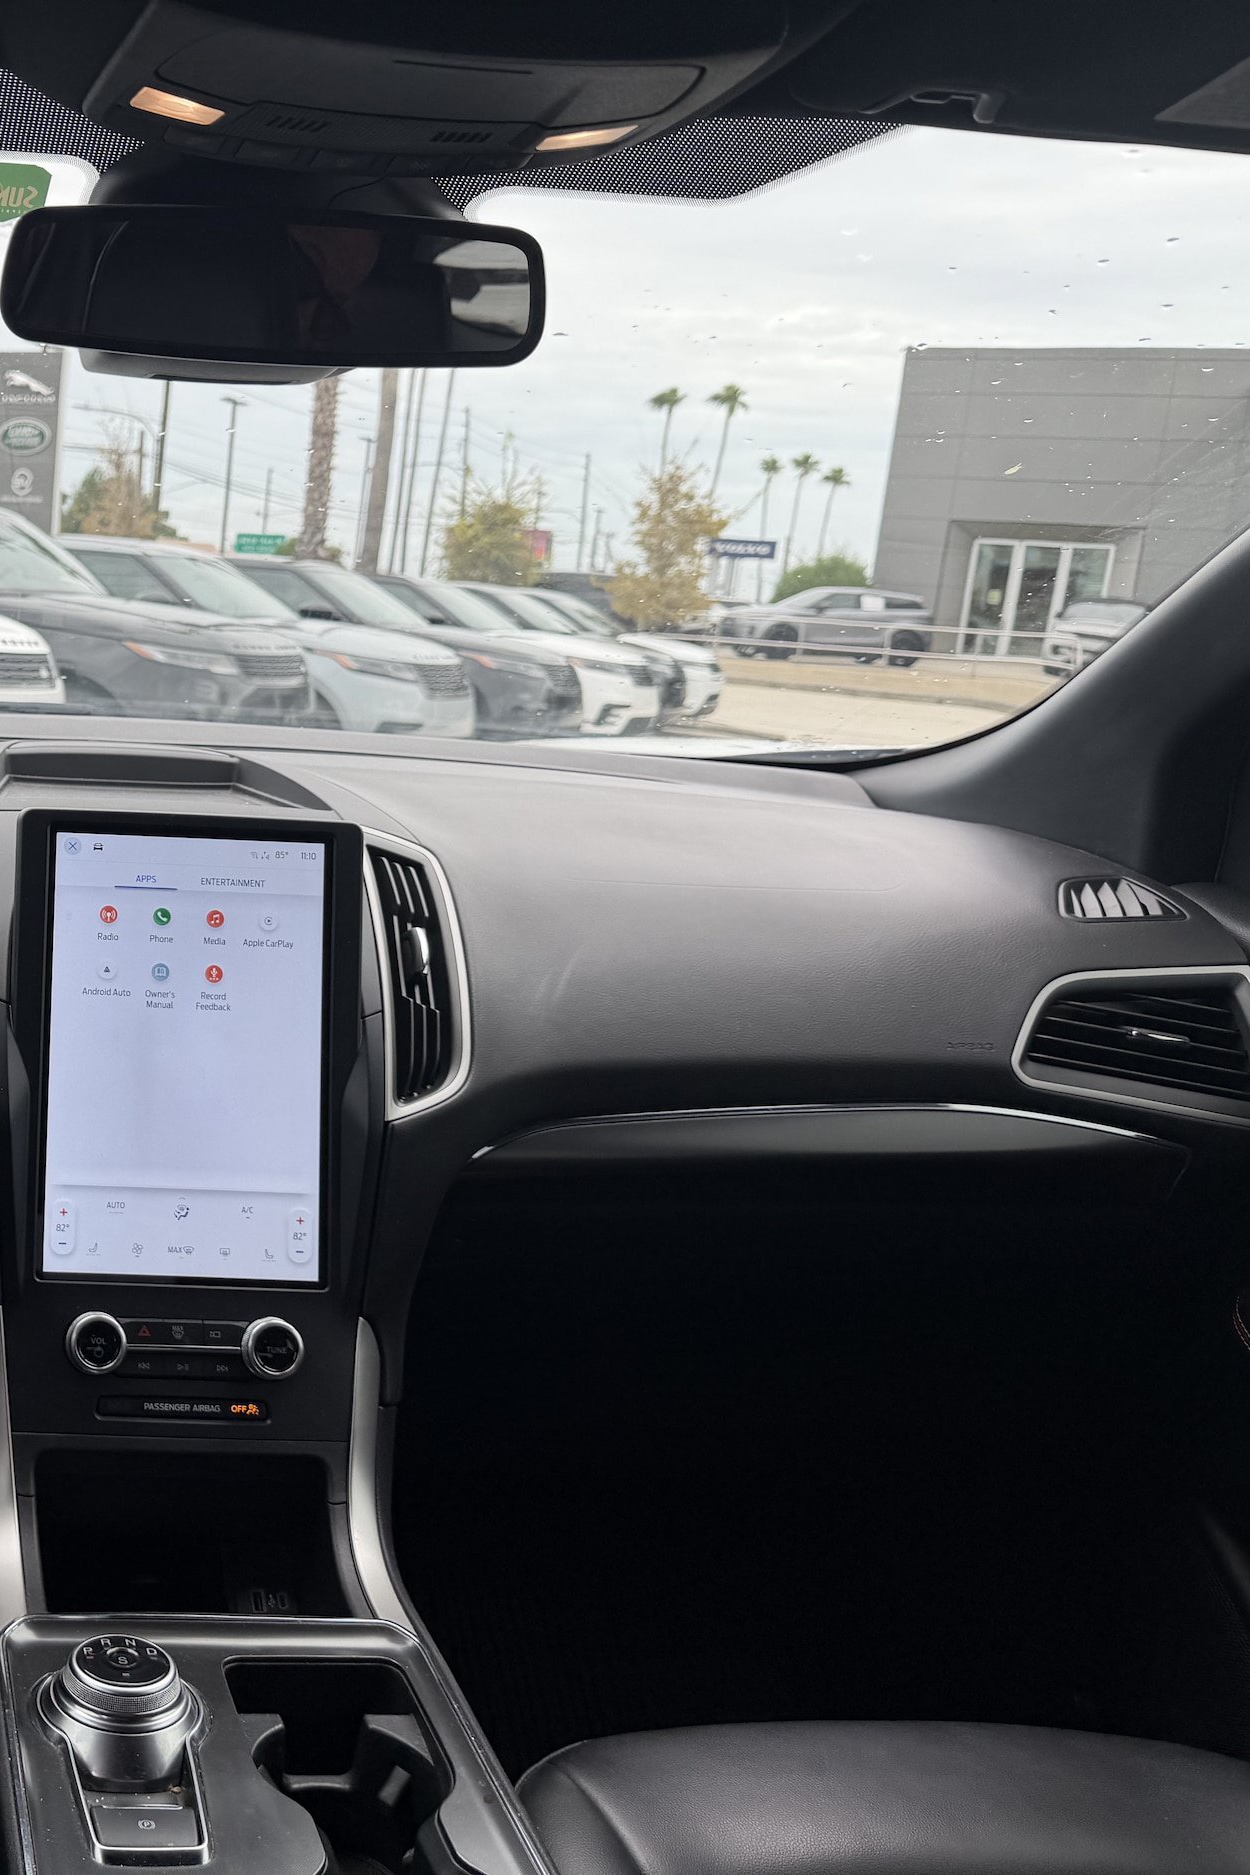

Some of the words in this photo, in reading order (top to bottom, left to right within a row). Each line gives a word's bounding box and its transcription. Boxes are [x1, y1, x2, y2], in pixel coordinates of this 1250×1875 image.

[301, 852, 316, 860] 11:10
[135, 875, 156, 883] APPS
[200, 878, 266, 888] ENTERTAINMENT
[97, 932, 118, 941] Radio
[149, 935, 173, 943] Phone
[203, 937, 226, 946] Media
[243, 938, 264, 948] Apple
[265, 939, 294, 949] CarPlay
[82, 987, 111, 996] Android
[113, 988, 131, 996] Auto
[144, 990, 175, 999] Owner's
[200, 992, 226, 1001] Record
[146, 1001, 174, 1010] Manual
[196, 1002, 231, 1012] Feedback
[106, 1202, 125, 1210] AUTO
[241, 1206, 253, 1214] A/C
[56, 1224, 70, 1232] 82°
[293, 1232, 307, 1240] 82°
[168, 1246, 183, 1254] MAX
[144, 1403, 190, 1412] PASSENGER
[192, 1404, 221, 1413] AIRBAG
[231, 1405, 247, 1413] OFF
[146, 1648, 157, 1656] D
[118, 1656, 128, 1664] S
